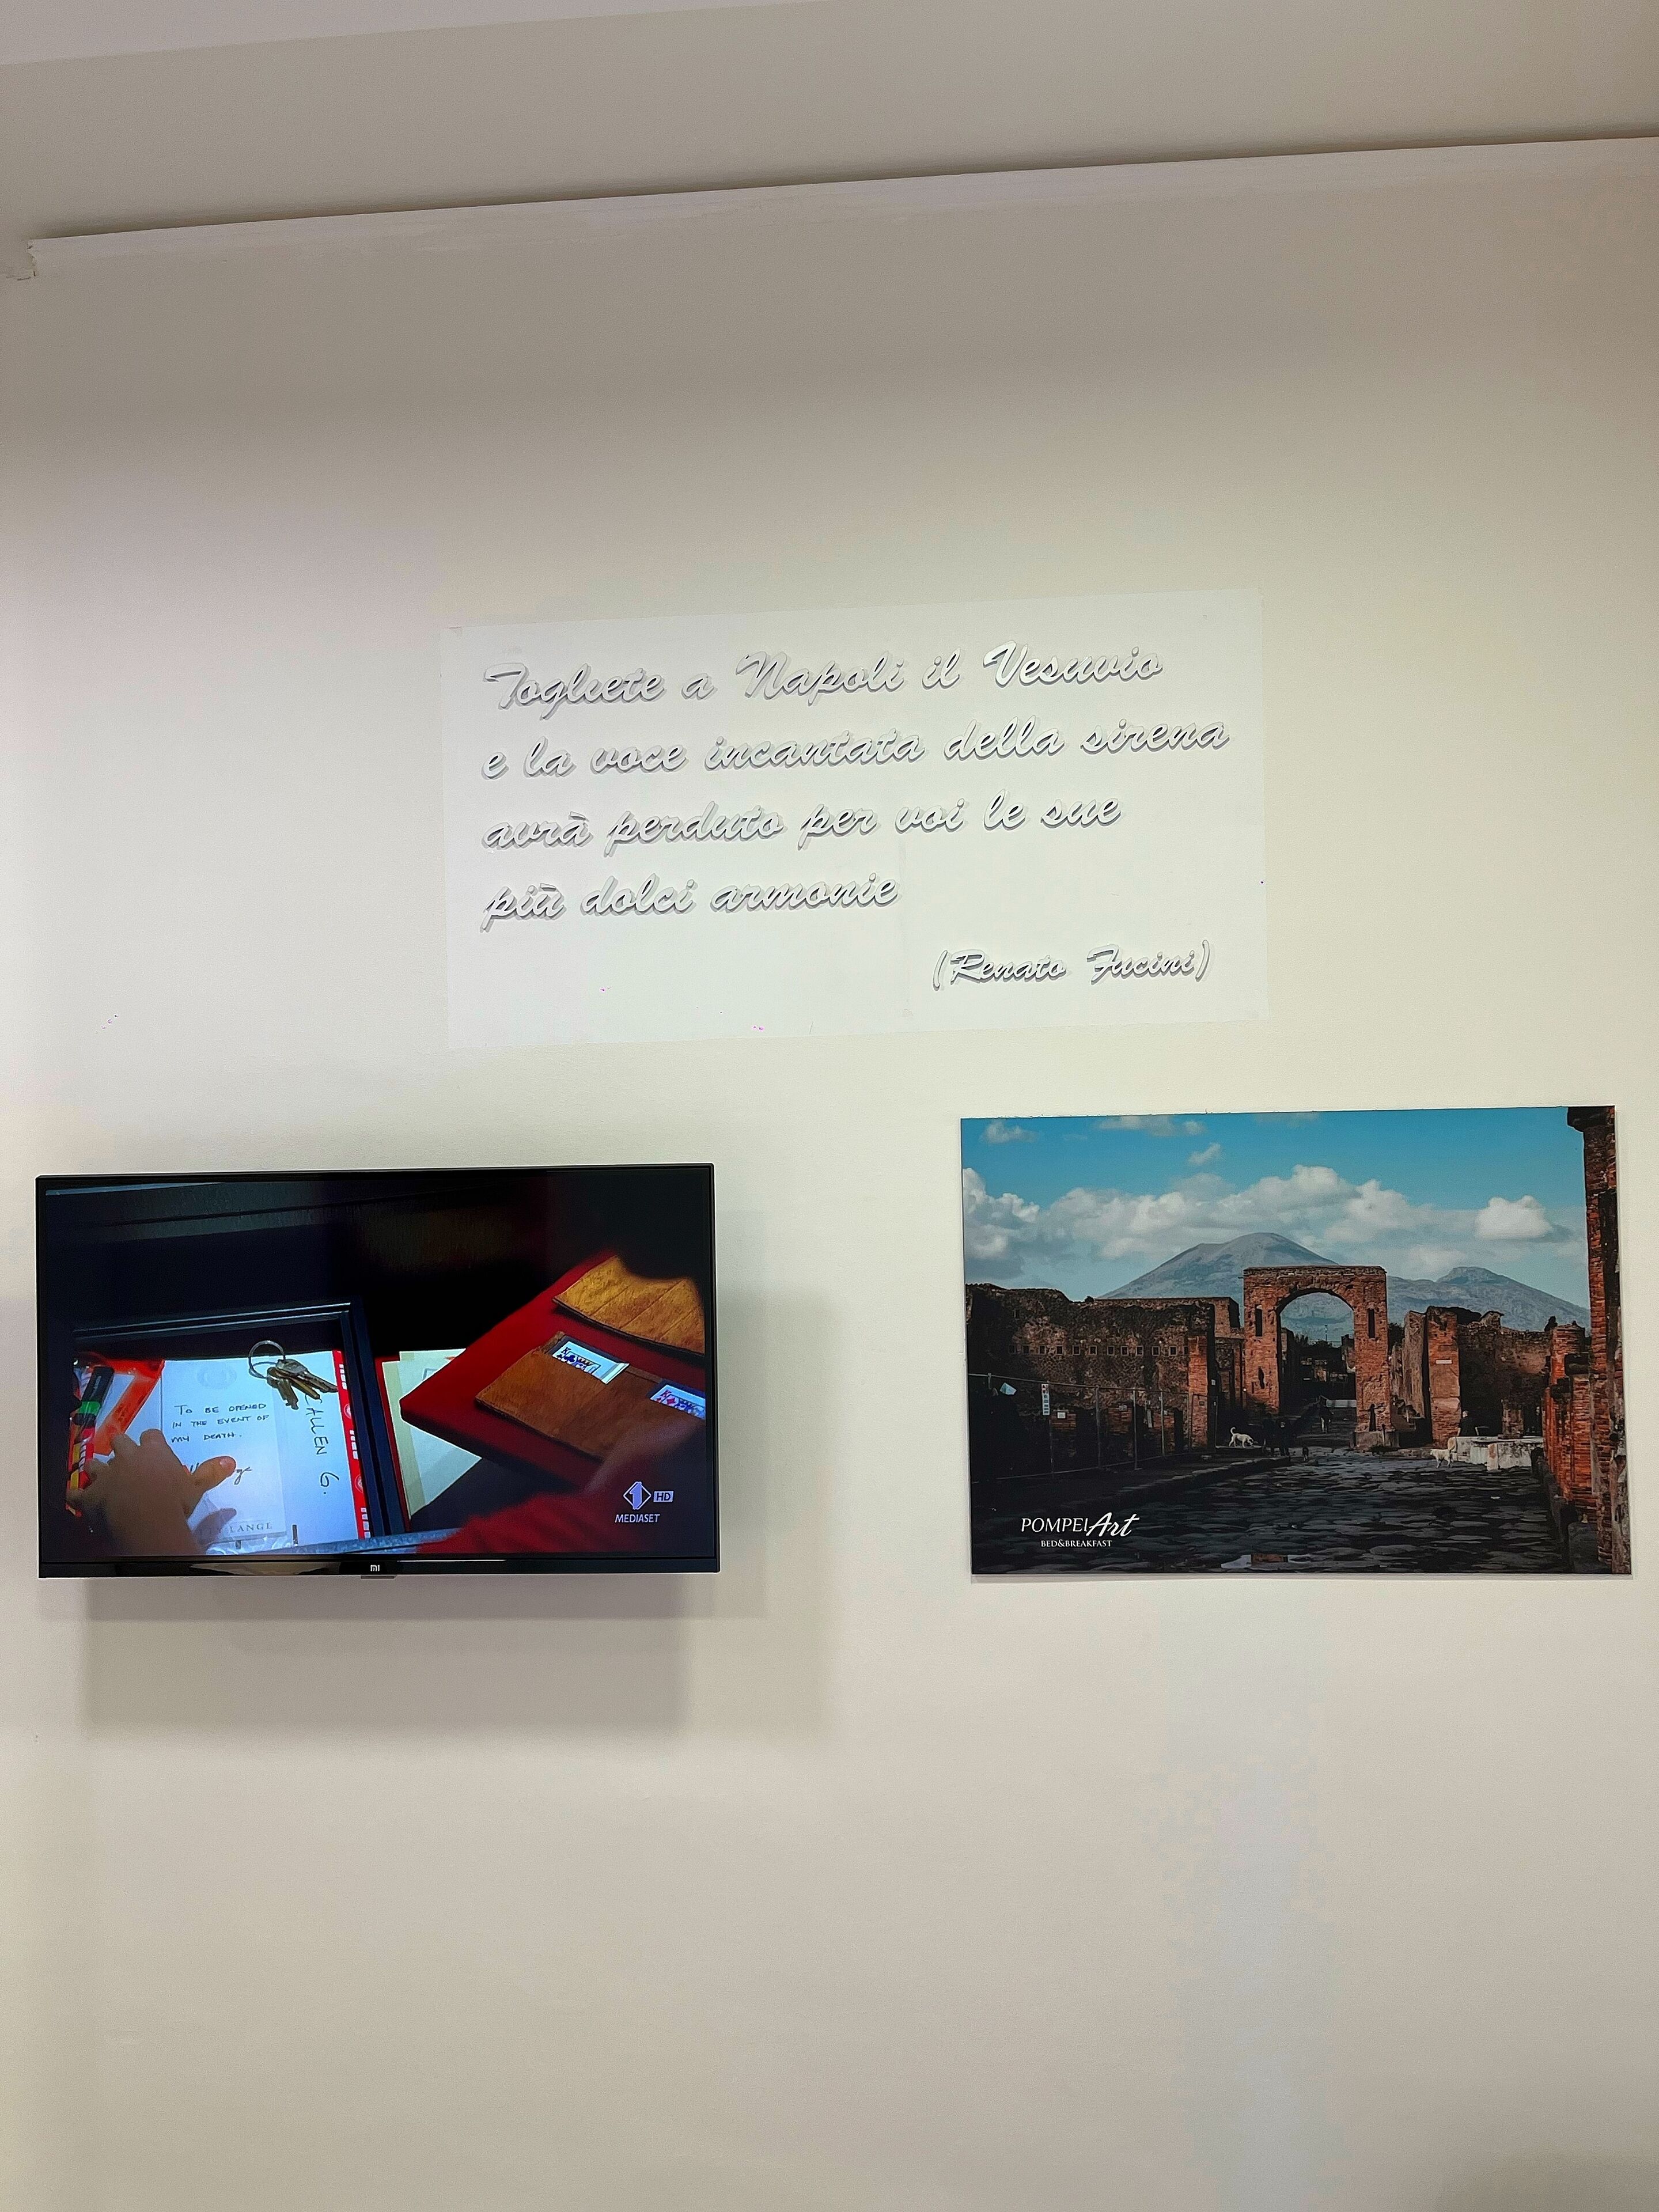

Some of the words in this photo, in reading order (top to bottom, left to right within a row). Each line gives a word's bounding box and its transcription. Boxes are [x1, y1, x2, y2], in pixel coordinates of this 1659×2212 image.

[483, 662, 665, 720] Togliete
[681, 672, 715, 700] a
[736, 652, 910, 706] Napoli
[922, 647, 962, 690] il
[983, 640, 1163, 688] Vesuvio
[482, 751, 508, 779] e
[522, 736, 575, 778] la
[590, 744, 689, 774] voce
[704, 728, 926, 771] incantata
[943, 715, 1066, 762] della
[1081, 718, 1231, 755] sirena
[482, 811, 593, 849] avrà
[604, 801, 785, 857] perduto
[797, 803, 878, 851] per
[895, 798, 965, 834] voi
[984, 789, 1027, 831] le
[1040, 798, 1123, 827] sue
[480, 882, 566, 932] più
[580, 873, 698, 916] dolci
[710, 873, 900, 912] armonie
[932, 949, 1067, 991] (Renato
[1086, 940, 1211, 986] Fucini)
[217, 1416, 252, 1425] EVENT
[229, 1403, 267, 1412] OPENED
[615, 1514, 661, 1523] MEDIASET
[656, 1492, 671, 1501] HD
